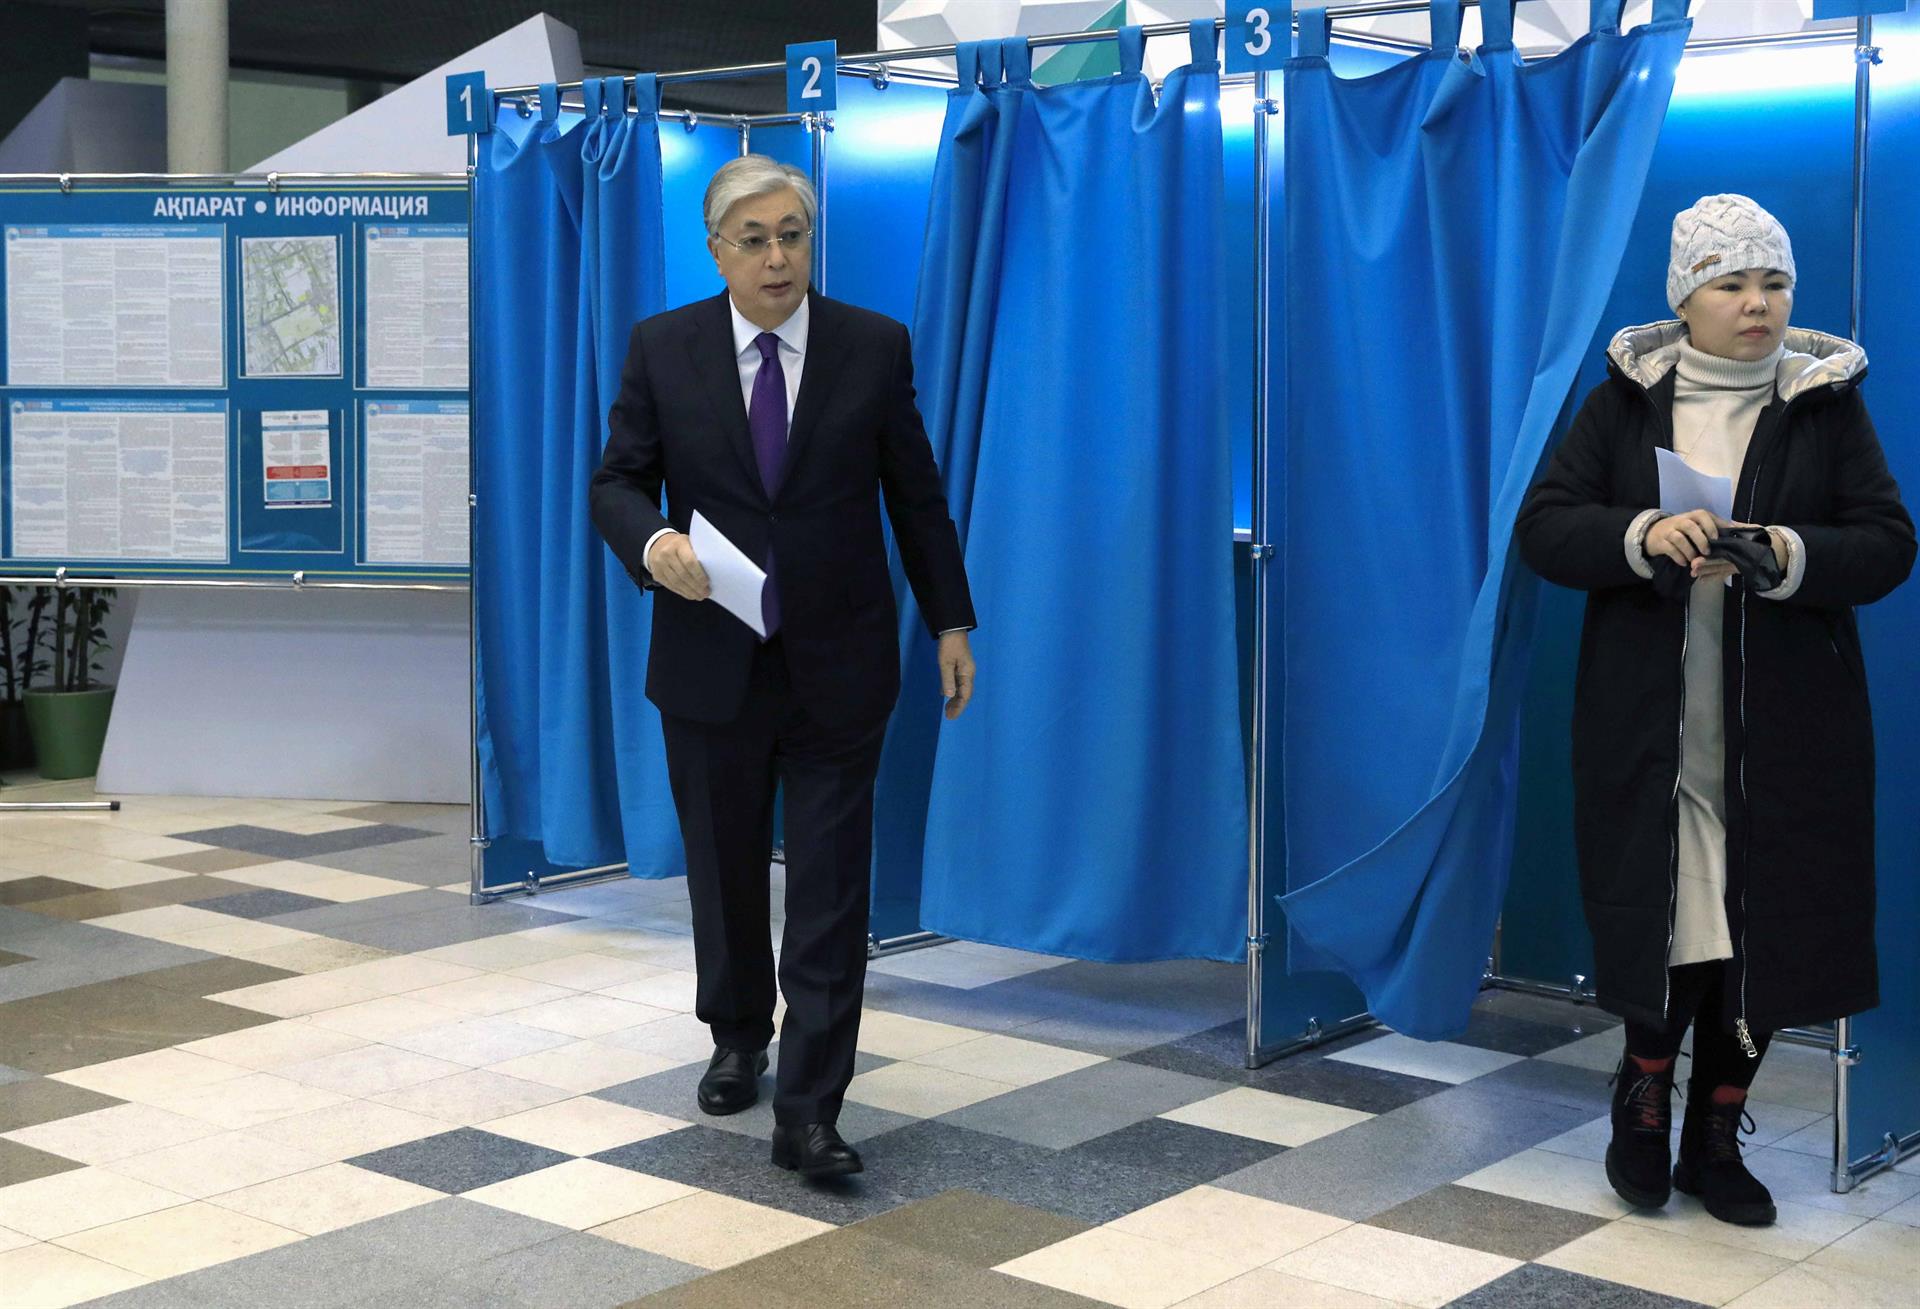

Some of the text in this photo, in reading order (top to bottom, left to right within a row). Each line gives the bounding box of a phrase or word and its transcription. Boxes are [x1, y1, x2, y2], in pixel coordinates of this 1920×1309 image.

[1244, 8, 1272, 56] 3
[801, 56, 822, 99] 2
[460, 85, 472, 122] 1
[153, 196, 429, 220] АҚПАРАТ ИНФОРМАЦИЯ
